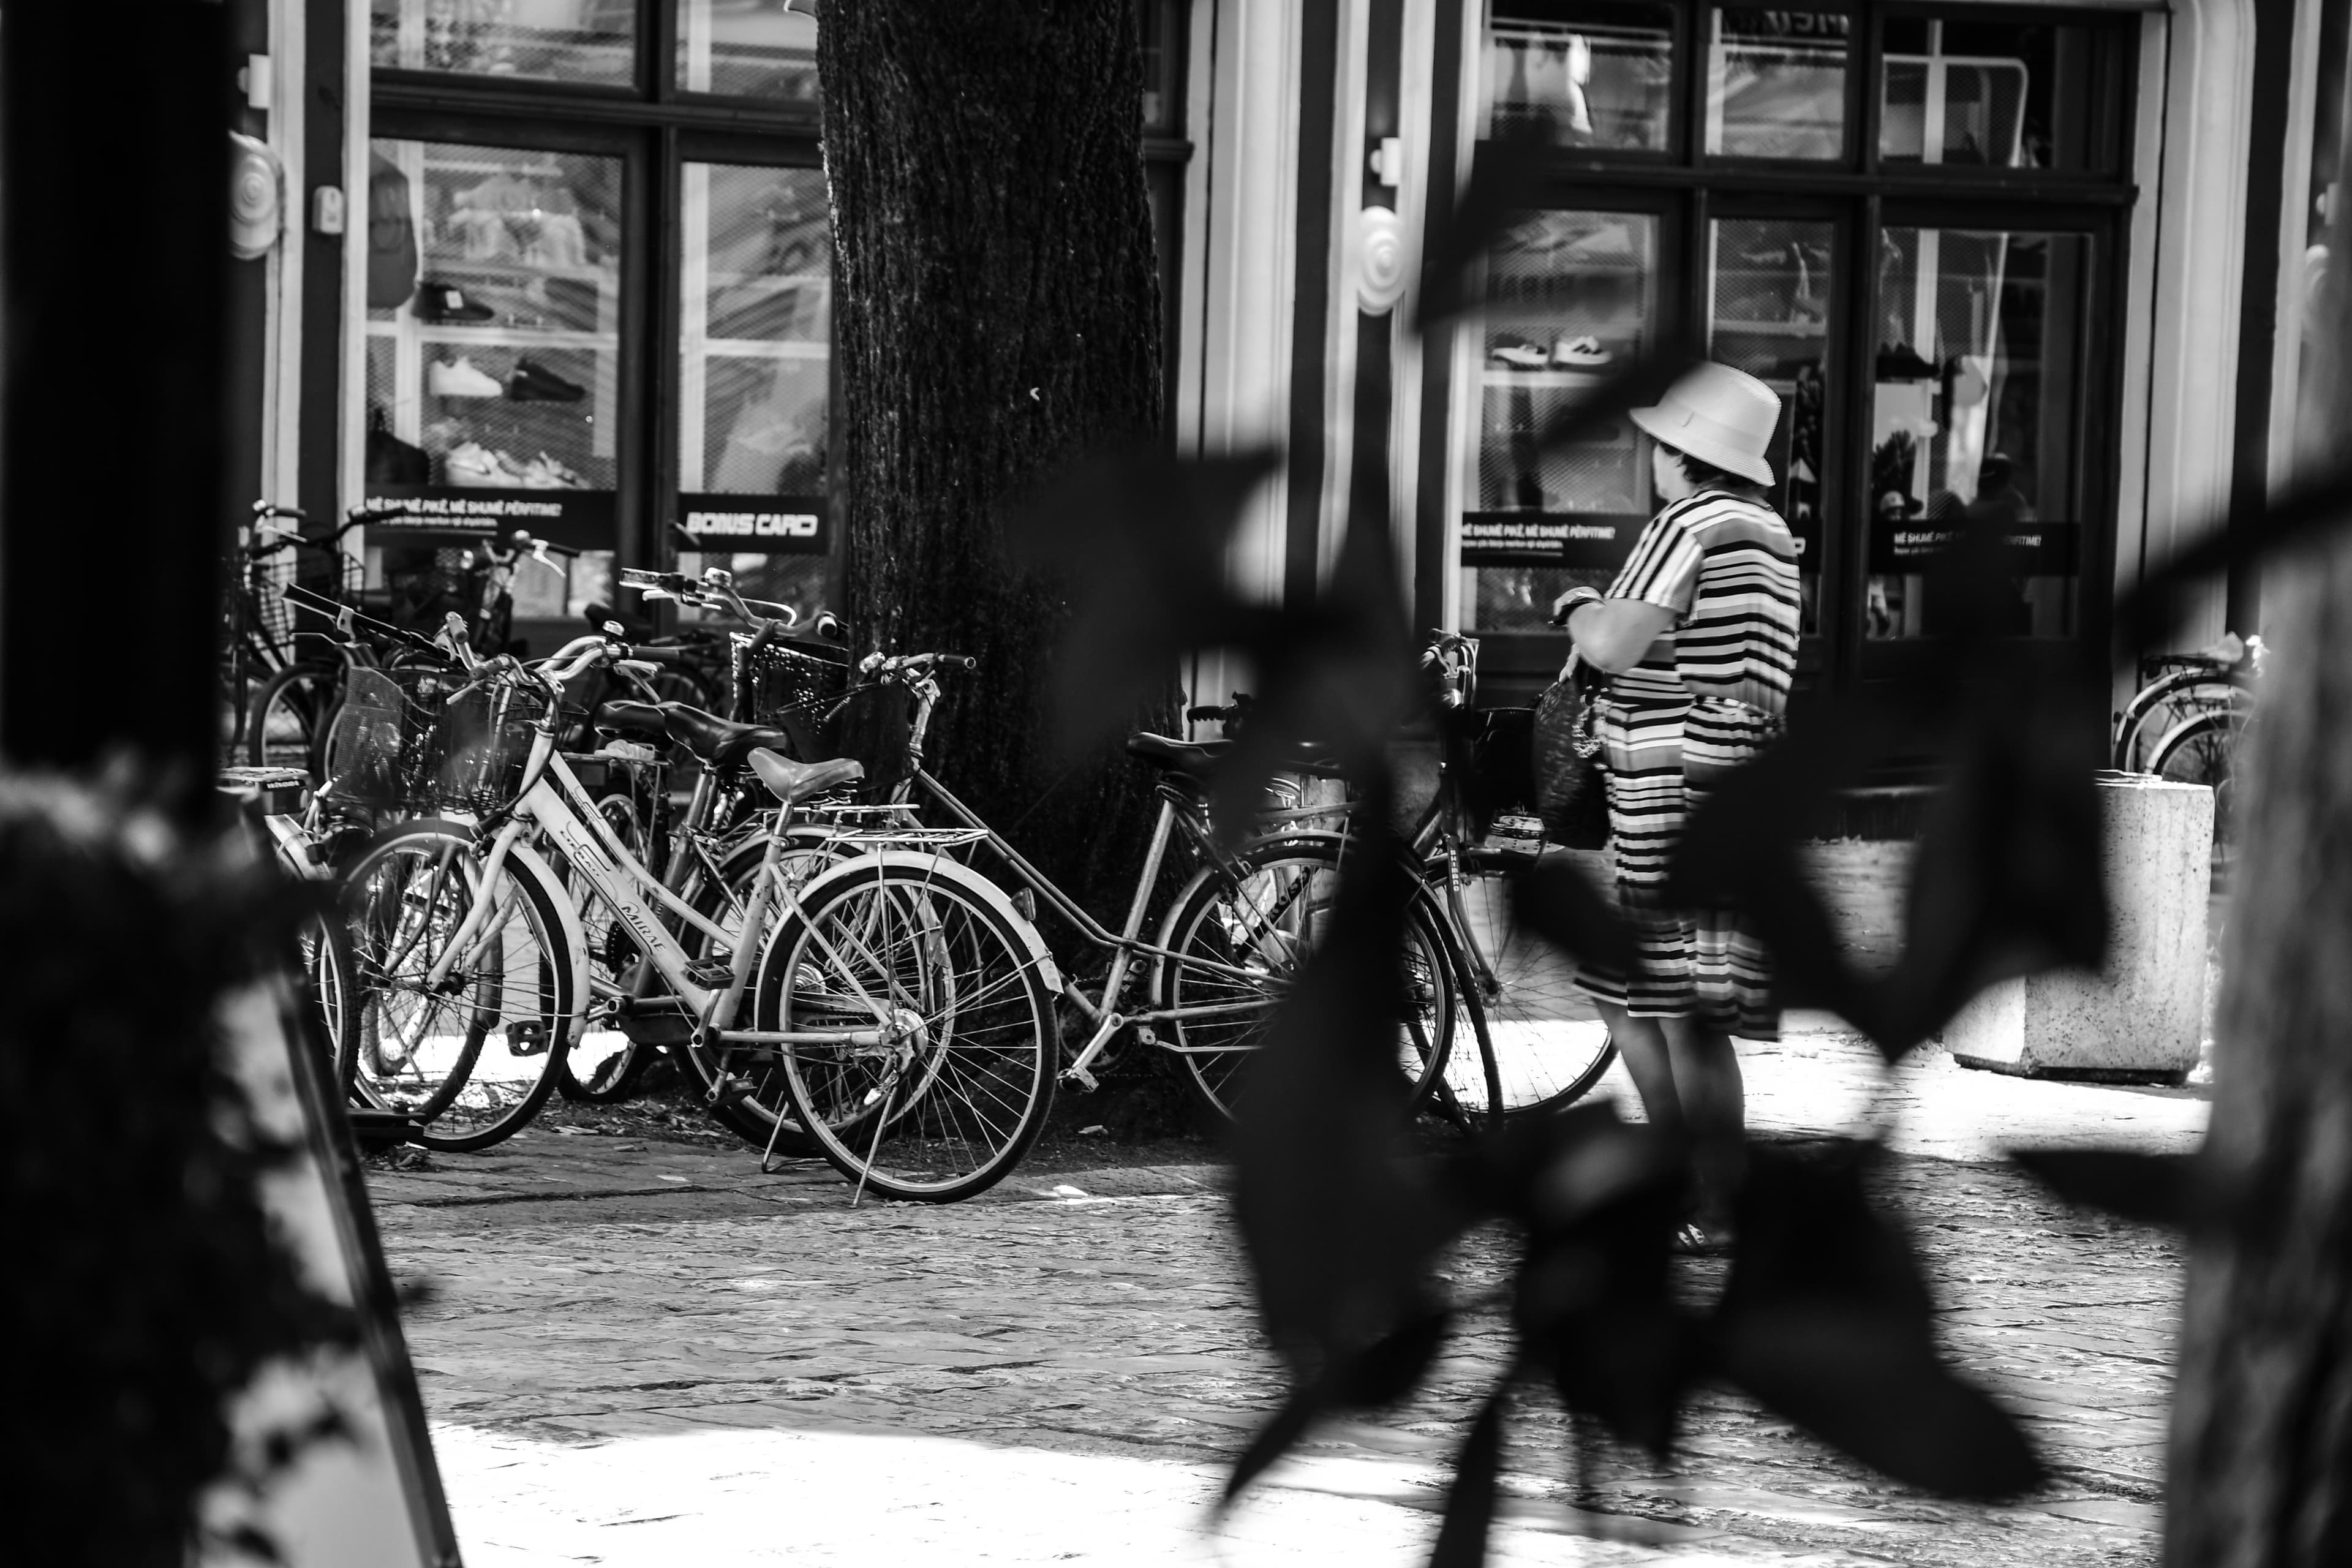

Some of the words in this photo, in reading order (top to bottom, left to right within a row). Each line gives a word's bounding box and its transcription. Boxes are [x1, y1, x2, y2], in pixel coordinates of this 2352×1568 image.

[449, 499, 466, 514] MË
[467, 500, 504, 515] SHUMË
[687, 512, 755, 535] BONUS
[755, 514, 819, 537] CARD
[1525, 523, 1538, 537] MË
[1894, 532, 1907, 544] MË
[1907, 532, 1935, 544] SHUMË
[620, 901, 666, 951] MIRAE
